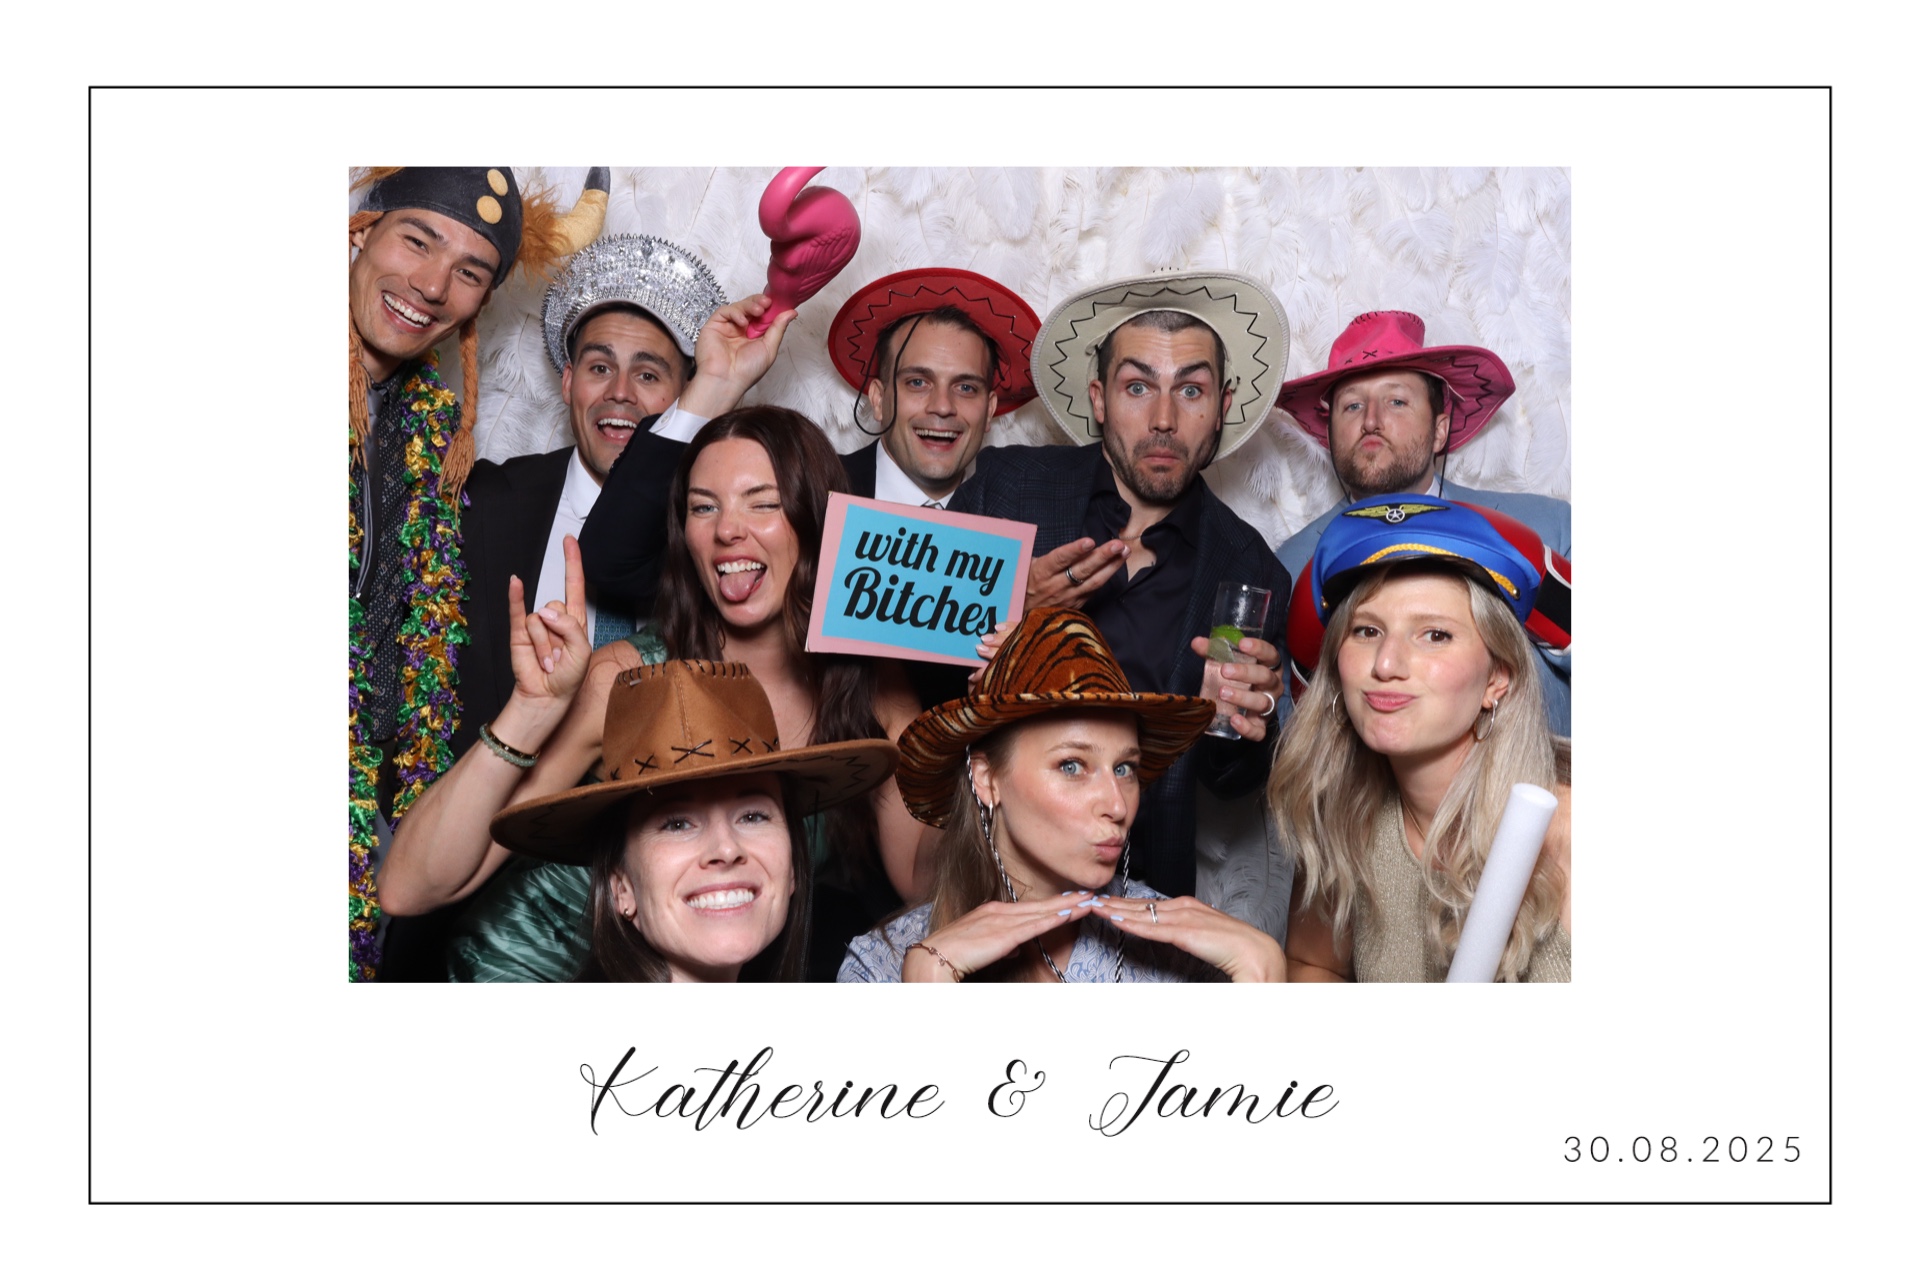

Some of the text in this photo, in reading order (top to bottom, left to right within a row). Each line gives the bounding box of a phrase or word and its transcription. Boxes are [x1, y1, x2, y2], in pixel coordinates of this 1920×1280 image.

[854, 526, 1005, 597] with my
[843, 566, 998, 638] Bitches
